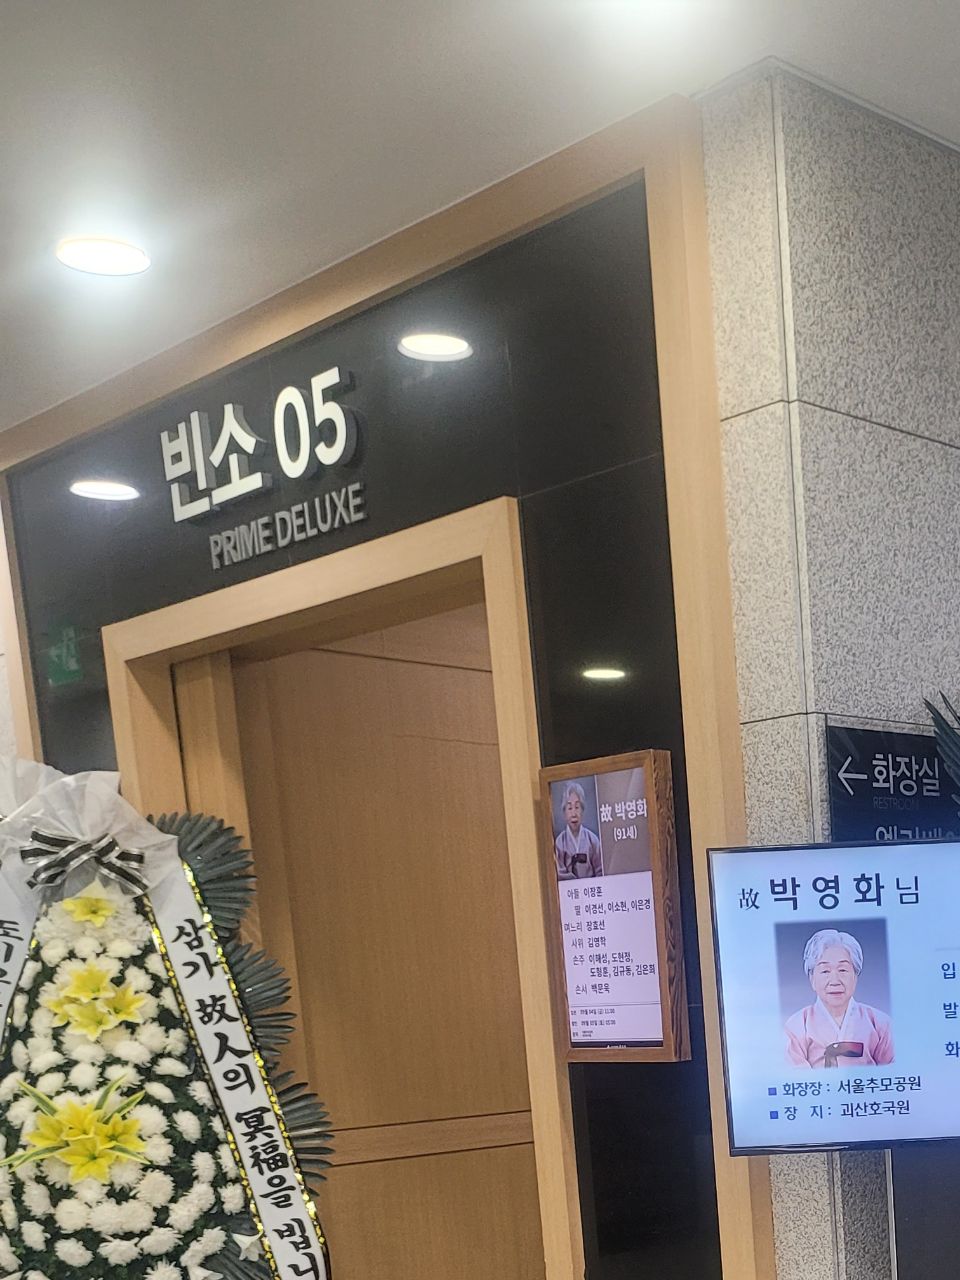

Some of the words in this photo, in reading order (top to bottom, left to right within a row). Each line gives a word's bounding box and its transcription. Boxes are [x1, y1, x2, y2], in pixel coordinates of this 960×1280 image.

[160, 403, 262, 522] 빈소
[274, 366, 347, 479] 05
[209, 516, 274, 570] PRIME
[275, 482, 368, 548] DELUXE
[872, 754, 940, 797] 화장실
[600, 804, 613, 822] 故
[615, 798, 648, 820] 박영화
[613, 825, 638, 841] (91세)
[567, 888, 580, 900] 아들
[738, 888, 760, 910] 故
[564, 921, 582, 933] 며느리
[172, 918, 221, 980] 삼가
[194, 994, 256, 1095] 故人의
[837, 1075, 922, 1095] 서울추모공원
[840, 1100, 911, 1118] 괴산호국원
[234, 1106, 297, 1209] 冥福을
